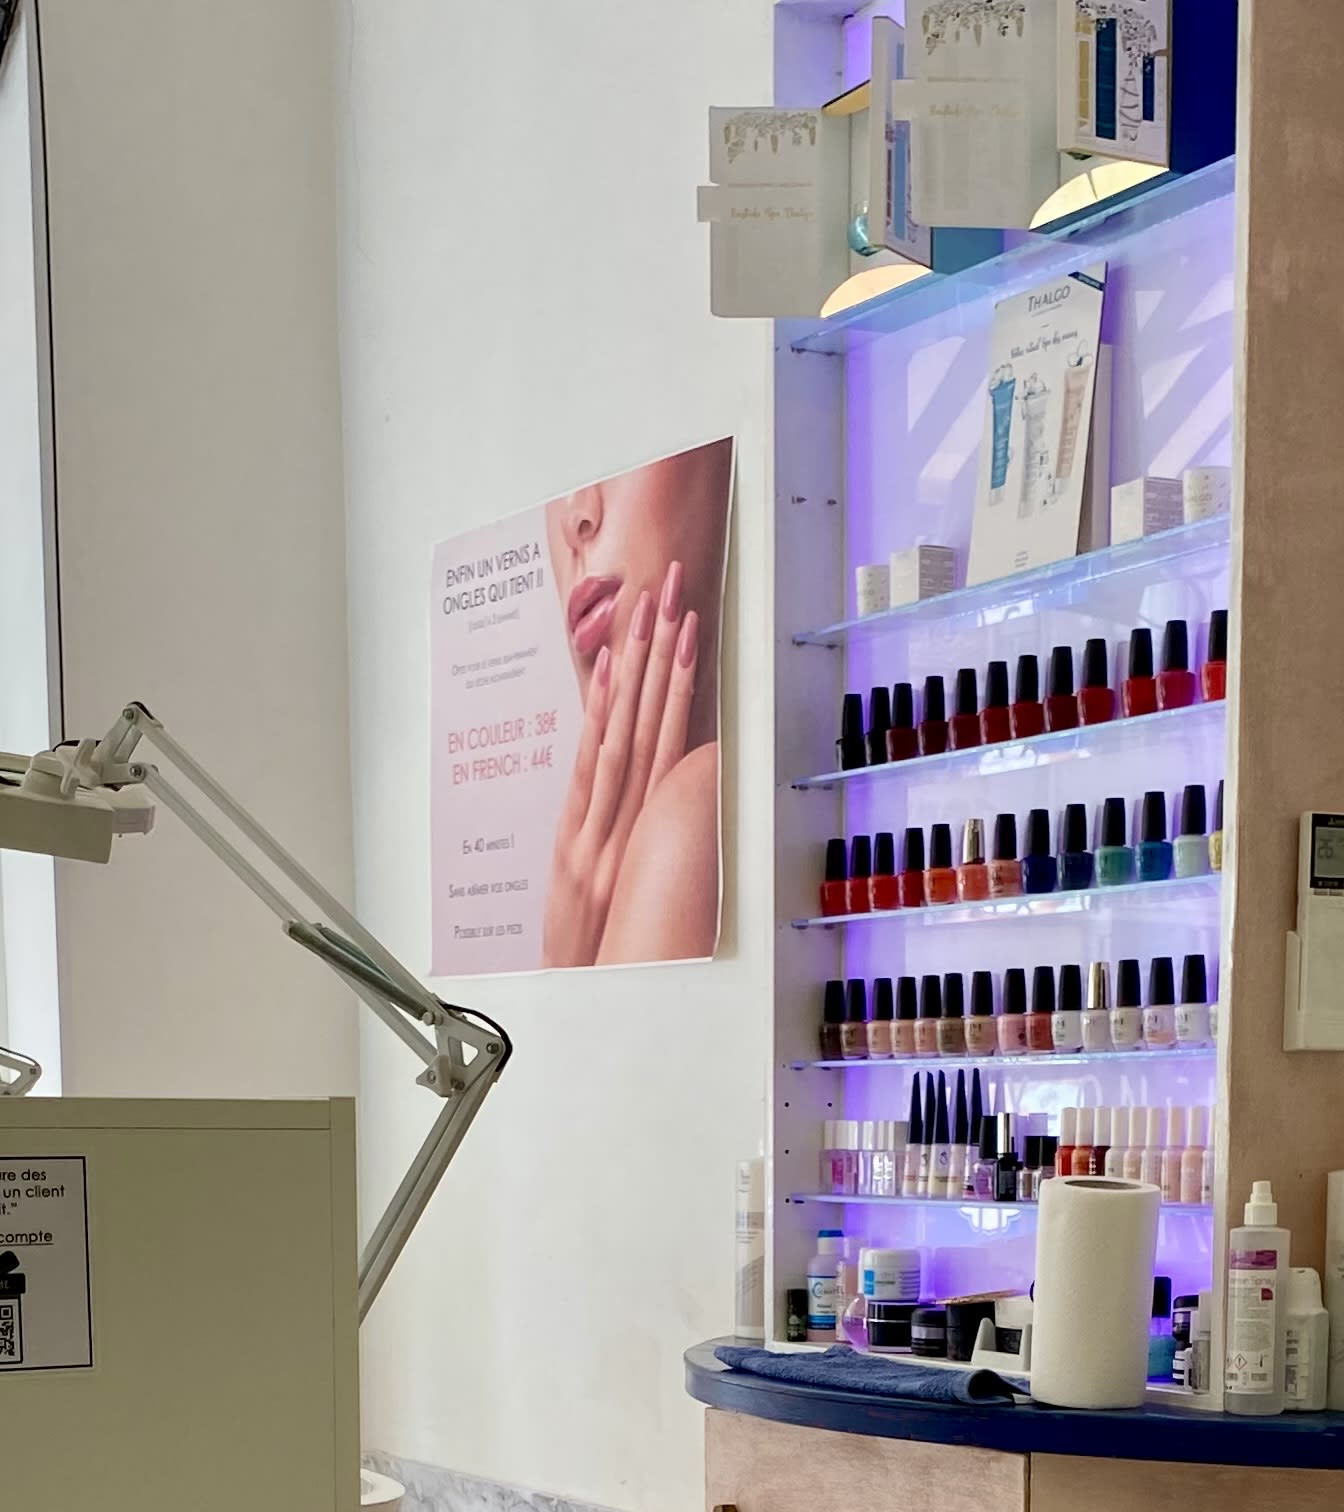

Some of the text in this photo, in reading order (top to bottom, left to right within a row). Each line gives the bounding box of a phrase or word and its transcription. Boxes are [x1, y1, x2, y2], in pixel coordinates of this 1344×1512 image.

[1028, 285, 1071, 312] THALGO
[446, 561, 475, 588] ENFIN
[477, 558, 493, 579] UN
[495, 543, 530, 571] VERNIS
[443, 587, 486, 615] ONGLES
[488, 580, 506, 603] QUI
[509, 571, 534, 596] TIENT
[448, 731, 465, 754] EN
[467, 718, 525, 752] COULEUR
[452, 763, 469, 785] EN
[472, 753, 521, 782] FRENCH
[21, 1169, 47, 1181] des
[3, 1187, 21, 1198] un
[26, 1185, 65, 1198] client
